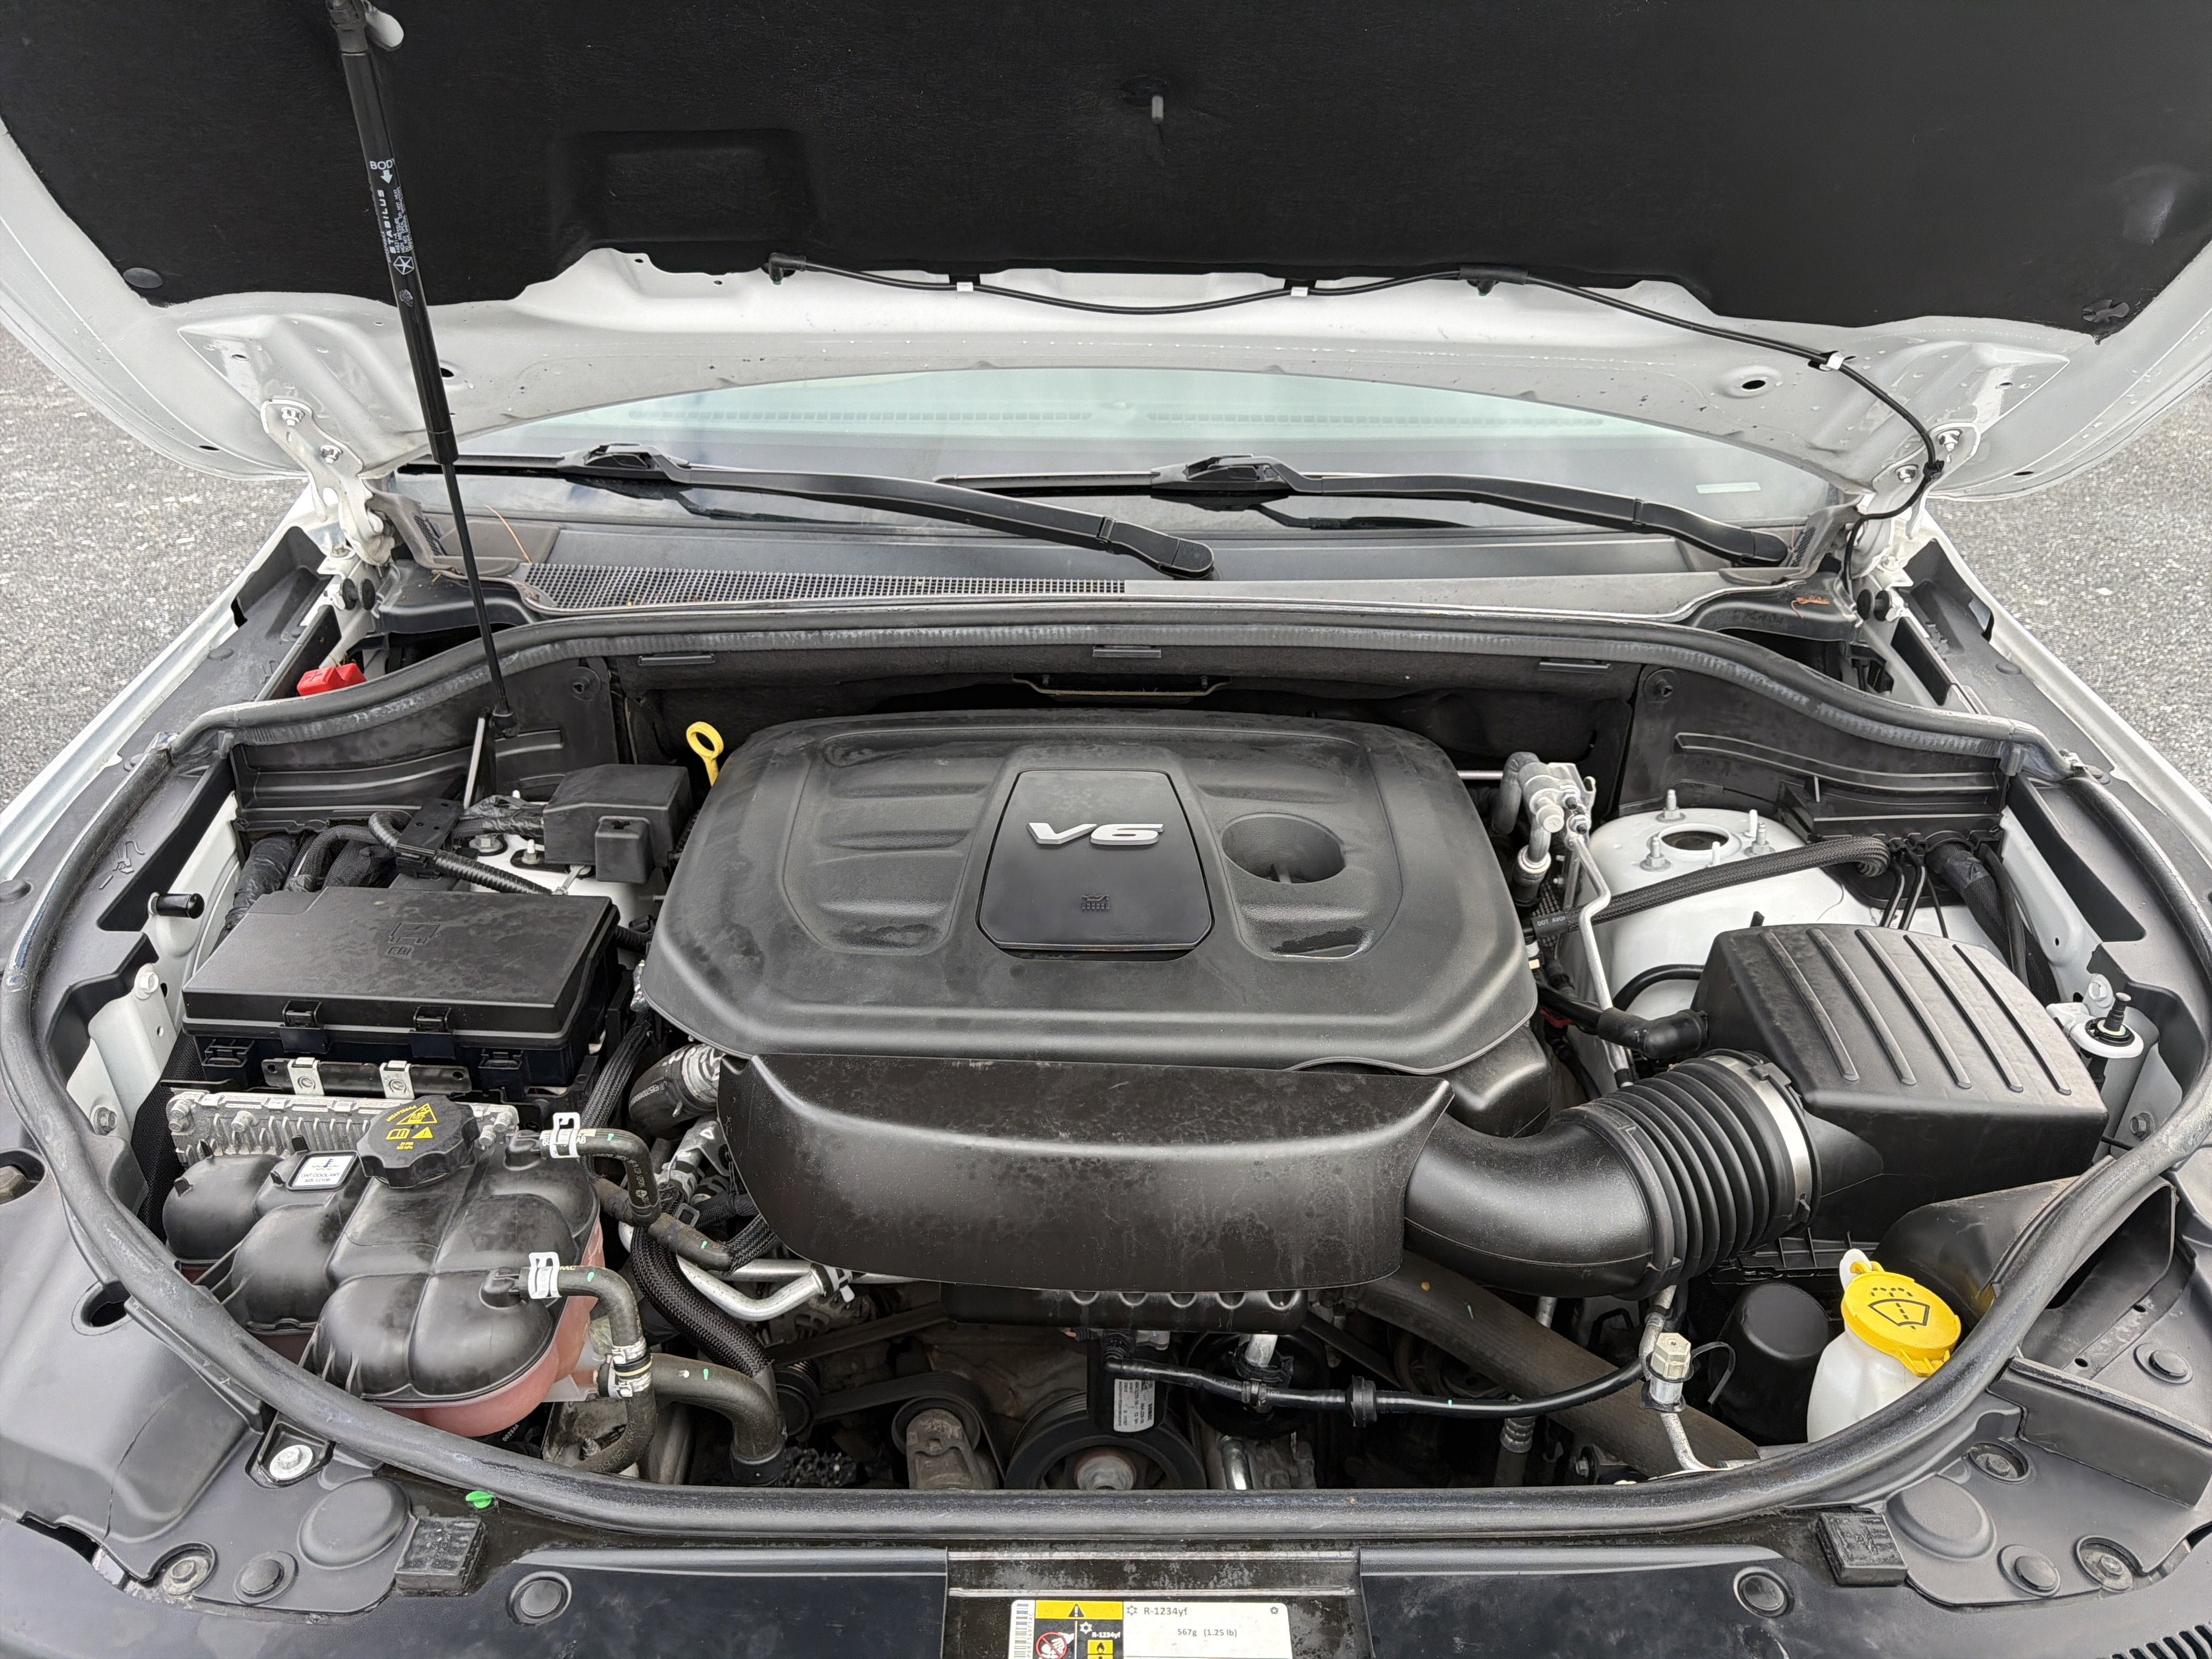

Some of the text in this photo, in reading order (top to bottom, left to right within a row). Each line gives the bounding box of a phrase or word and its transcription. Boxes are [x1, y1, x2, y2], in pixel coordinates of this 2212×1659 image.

[377, 189, 396, 254] STABILUS
[1026, 822, 1165, 845] V6
[1144, 1607, 1188, 1617] R-1234yf
[1204, 1628, 1224, 1637] (1.25
[1226, 1628, 1237, 1637] lb)
